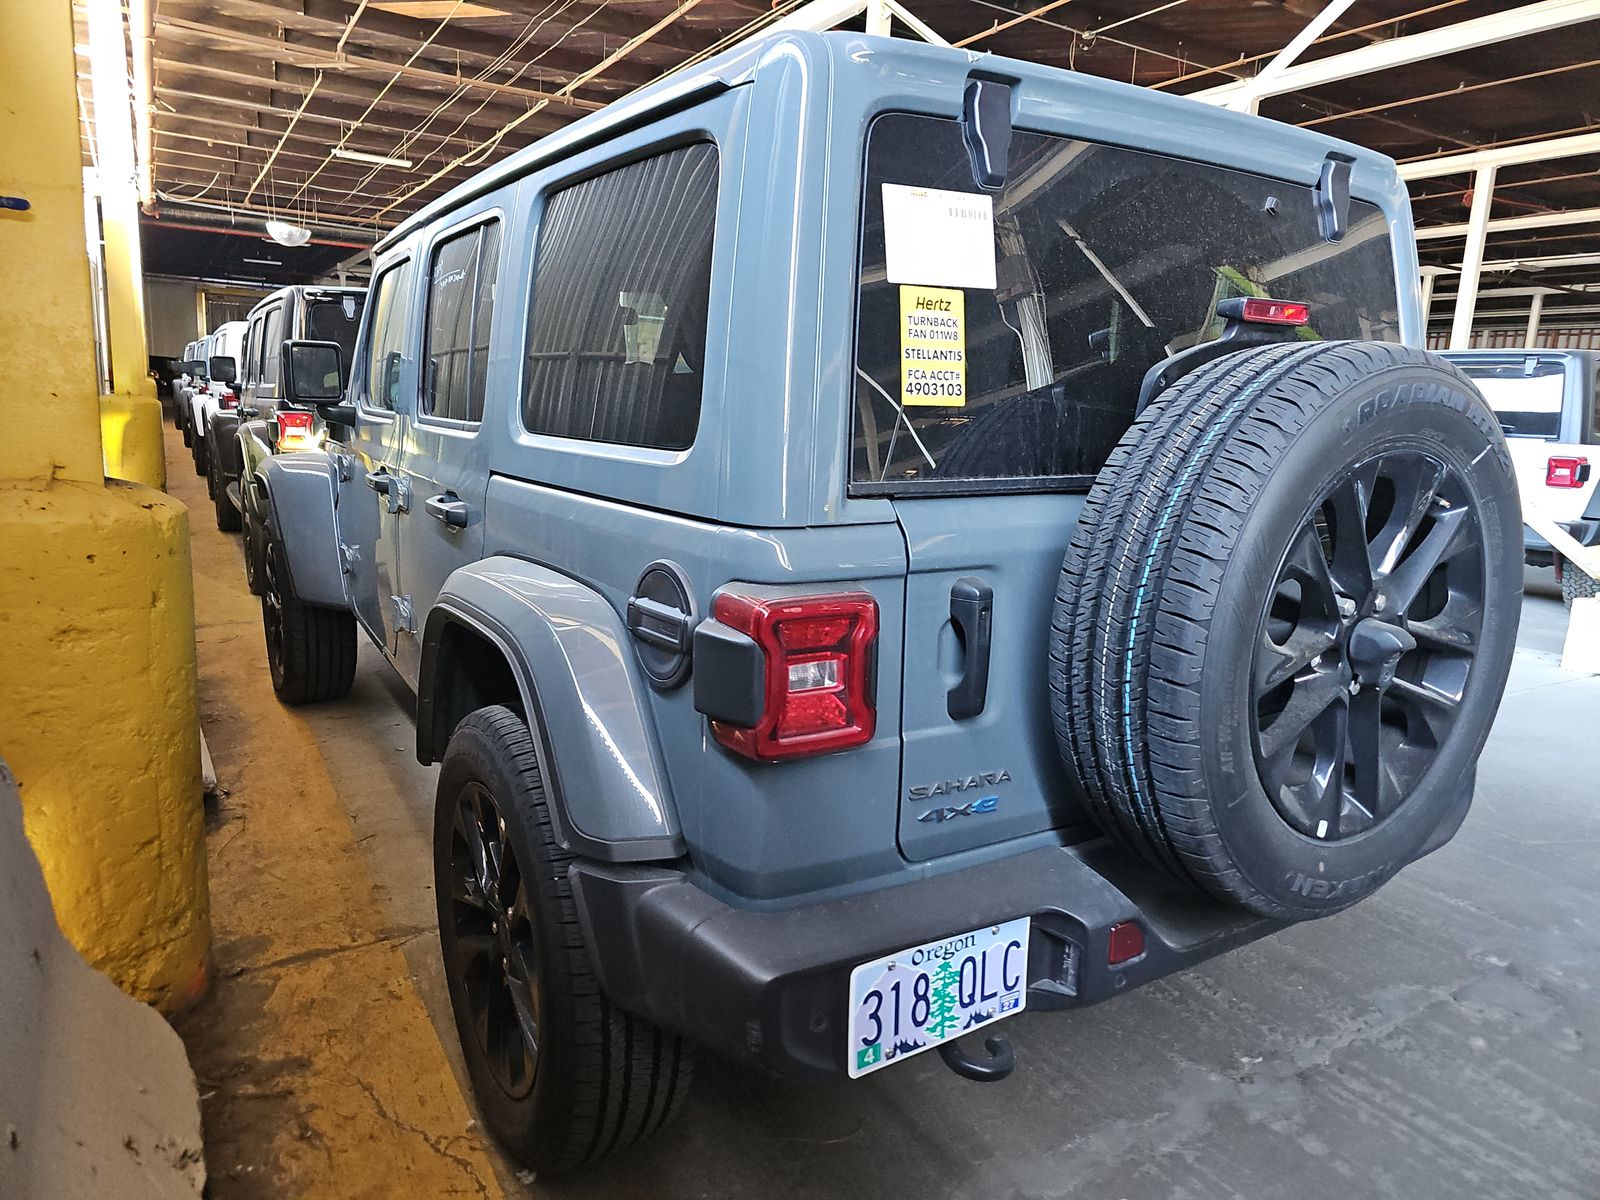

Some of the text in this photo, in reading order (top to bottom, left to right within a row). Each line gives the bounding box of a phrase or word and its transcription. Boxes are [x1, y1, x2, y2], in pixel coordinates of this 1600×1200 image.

[915, 296, 952, 312] Hertz
[907, 315, 959, 328] TURNBACK
[908, 328, 959, 341] FAN 011W8
[904, 348, 963, 362] STELLANTIS
[908, 369, 960, 382] FCA ACCT#
[905, 382, 963, 397] 4903103
[908, 769, 1013, 801] SAHARA
[911, 934, 976, 966] Oregon
[861, 940, 1022, 1047] 318 QLC
[1002, 1000, 1016, 1011] 27
[863, 1047, 875, 1064] 4
